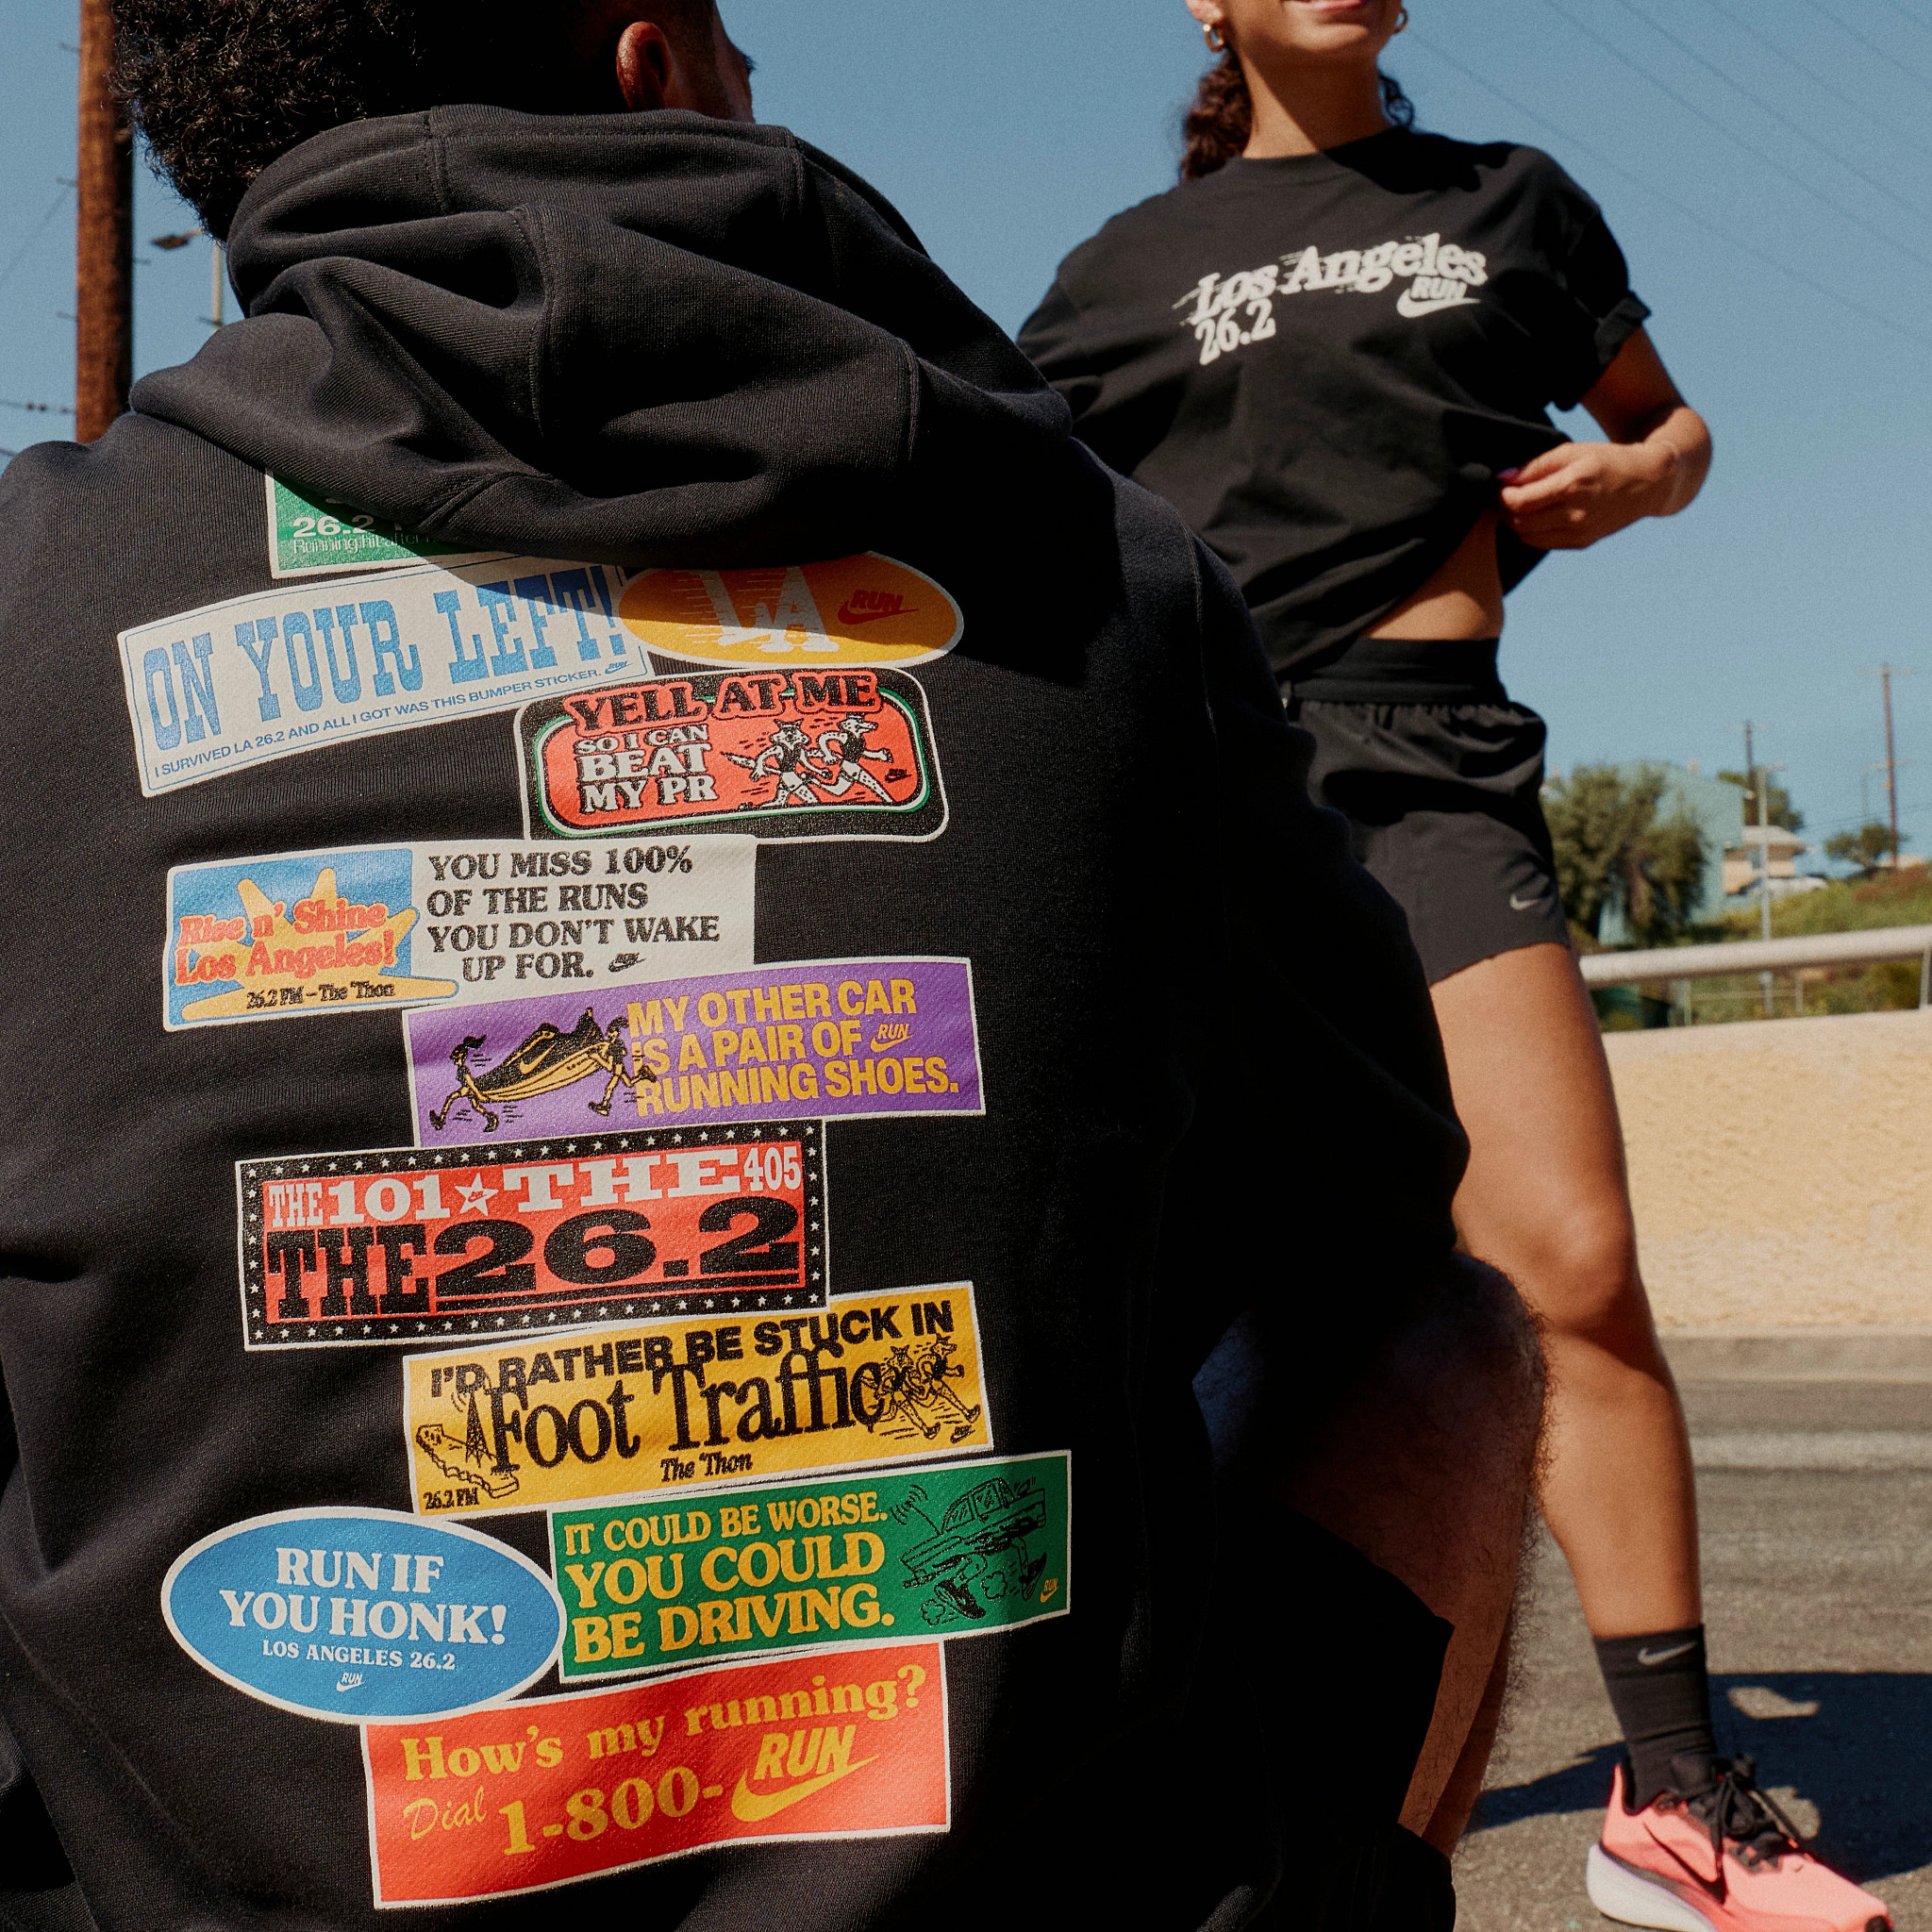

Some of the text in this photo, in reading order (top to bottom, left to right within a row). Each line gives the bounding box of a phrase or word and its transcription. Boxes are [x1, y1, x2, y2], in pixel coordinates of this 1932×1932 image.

[1191, 233, 1488, 325] Los Angeles
[1410, 275, 1467, 300] RUN
[1195, 298, 1276, 365] 26.2
[292, 513, 375, 538] 26.2
[292, 534, 359, 555] Running
[851, 589, 904, 612] RUN
[142, 565, 627, 751] ON YOUR LEFT!
[161, 746, 231, 775] SURVIVED
[235, 740, 253, 754] LA
[255, 731, 285, 747] 26.2
[289, 724, 320, 740] AND
[323, 716, 350, 731] ALL
[359, 708, 391, 722] GOT
[394, 701, 429, 716] WAS
[431, 694, 466, 708] THIS
[469, 682, 532, 702] BUMPER
[535, 670, 601, 688] STICKER.
[574, 675, 877, 731] YELL AT ME
[575, 724, 709, 755] SO I CAN
[577, 743, 711, 782] BEAT
[579, 774, 718, 813] MY PR
[428, 844, 692, 880] YOU MISS 100%
[177, 914, 244, 947] Rise
[292, 898, 386, 934] Shine
[426, 881, 649, 917] OF THE RUNS
[175, 928, 394, 985] Los Angeles!
[427, 915, 721, 953] YOU DON'T WAKE
[462, 951, 594, 982] UP FOR.
[626, 978, 916, 1038] MY OTHER CAR
[876, 1023, 908, 1041] RUN
[631, 1019, 863, 1076] IS A PAIR OF
[636, 1056, 959, 1117] RUNNING SHOES.
[269, 1146, 803, 1228] THE 101 THE 405
[267, 1195, 800, 1319] THE 26.2
[431, 1300, 955, 1398] I'D RATHER BE STUCK IN
[484, 1341, 886, 1474] Foot Traffic
[660, 1457, 695, 1482] The
[424, 1491, 455, 1510] 26.2
[564, 1491, 888, 1556] IT COULD BE WORSE.
[275, 1547, 445, 1594] RUN IF
[564, 1531, 886, 1609] YOU COULD
[219, 1589, 508, 1645] YOU HONK!
[572, 1583, 895, 1664] BE DRIVING.
[262, 1639, 456, 1671] LOS ANGELES 26.2
[400, 1663, 927, 1782] How's my running?
[402, 1785, 488, 1841] Dial
